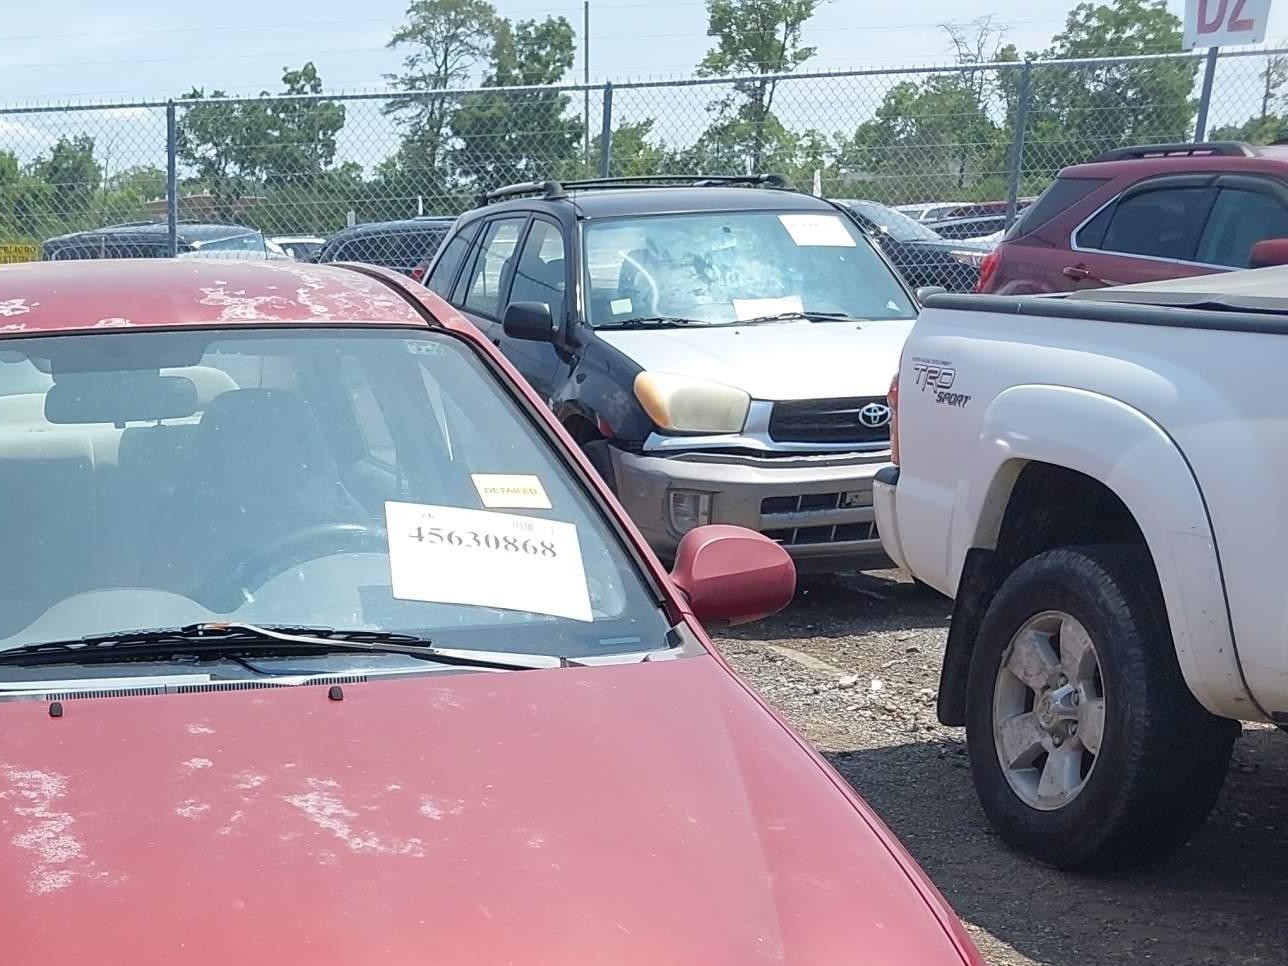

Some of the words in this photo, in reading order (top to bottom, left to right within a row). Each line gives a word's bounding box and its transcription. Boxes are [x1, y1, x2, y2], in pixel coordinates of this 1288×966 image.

[913, 363, 956, 394] TRD
[936, 391, 970, 408] SPORT
[484, 487, 538, 495] DETAILED
[408, 526, 558, 558] 45630868
